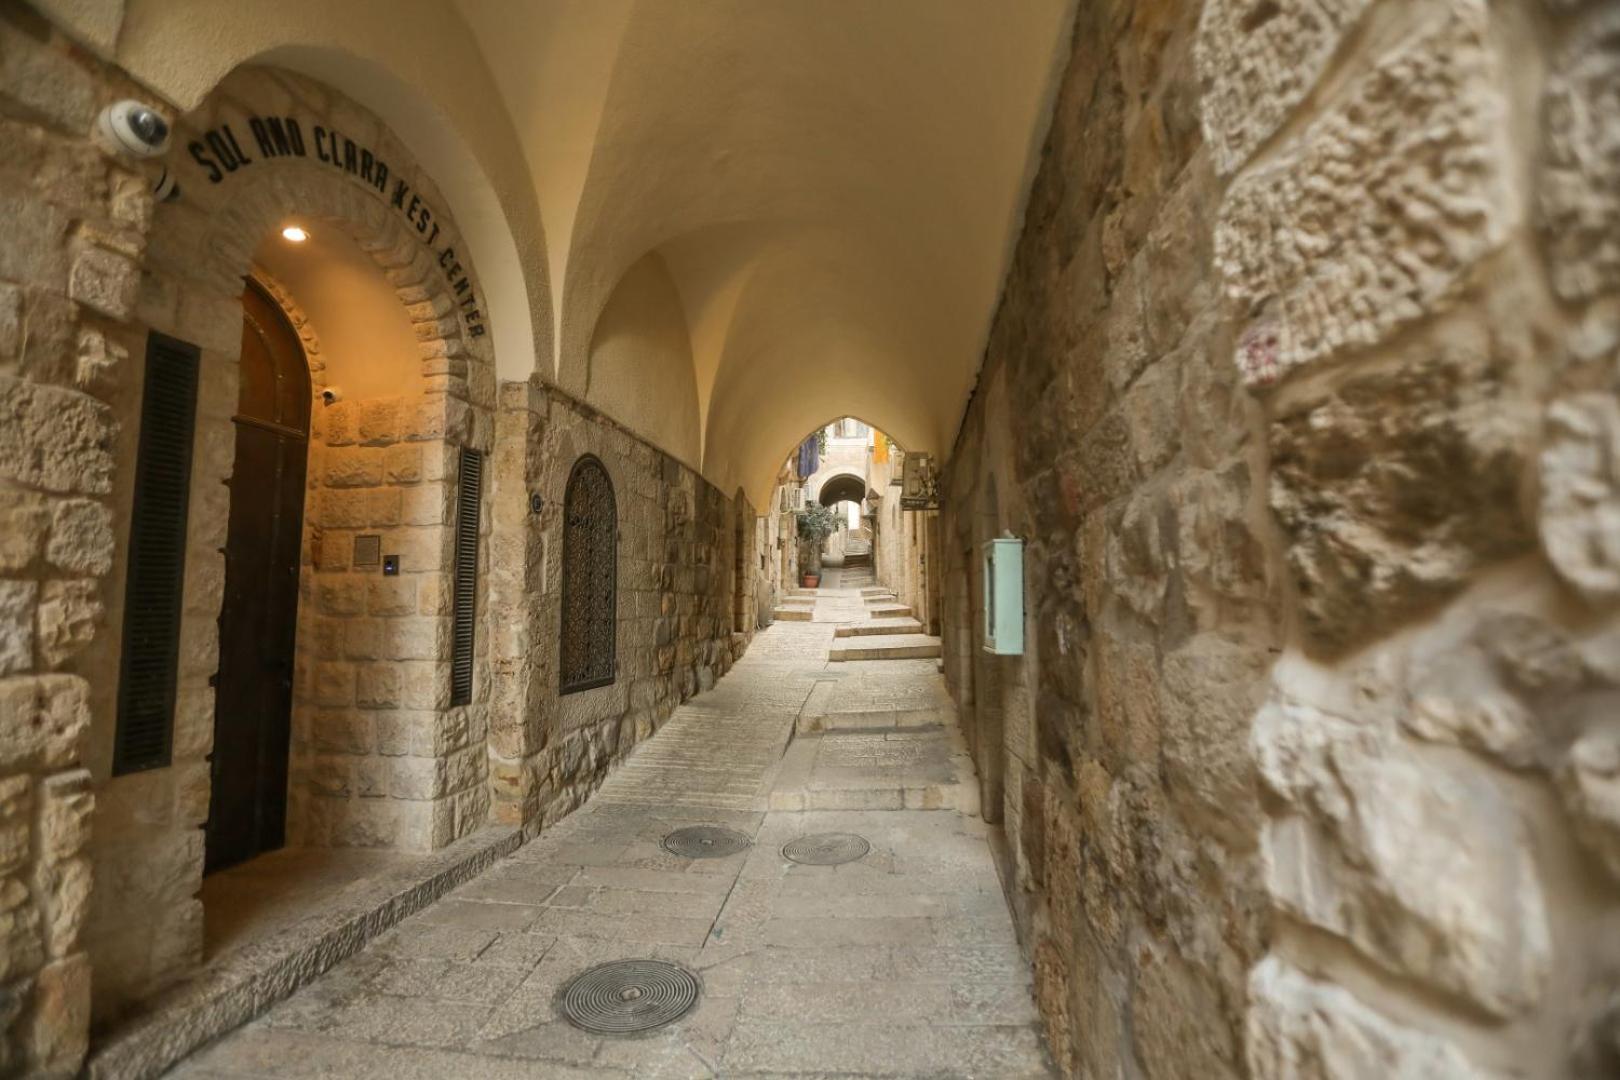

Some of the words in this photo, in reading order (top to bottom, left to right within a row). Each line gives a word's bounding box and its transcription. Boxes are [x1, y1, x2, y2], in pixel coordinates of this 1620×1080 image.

[188, 124, 251, 183] SOL
[248, 116, 307, 158] AND
[314, 126, 389, 193] CLARA
[391, 180, 440, 245] KEST
[439, 247, 486, 339] CENTER
